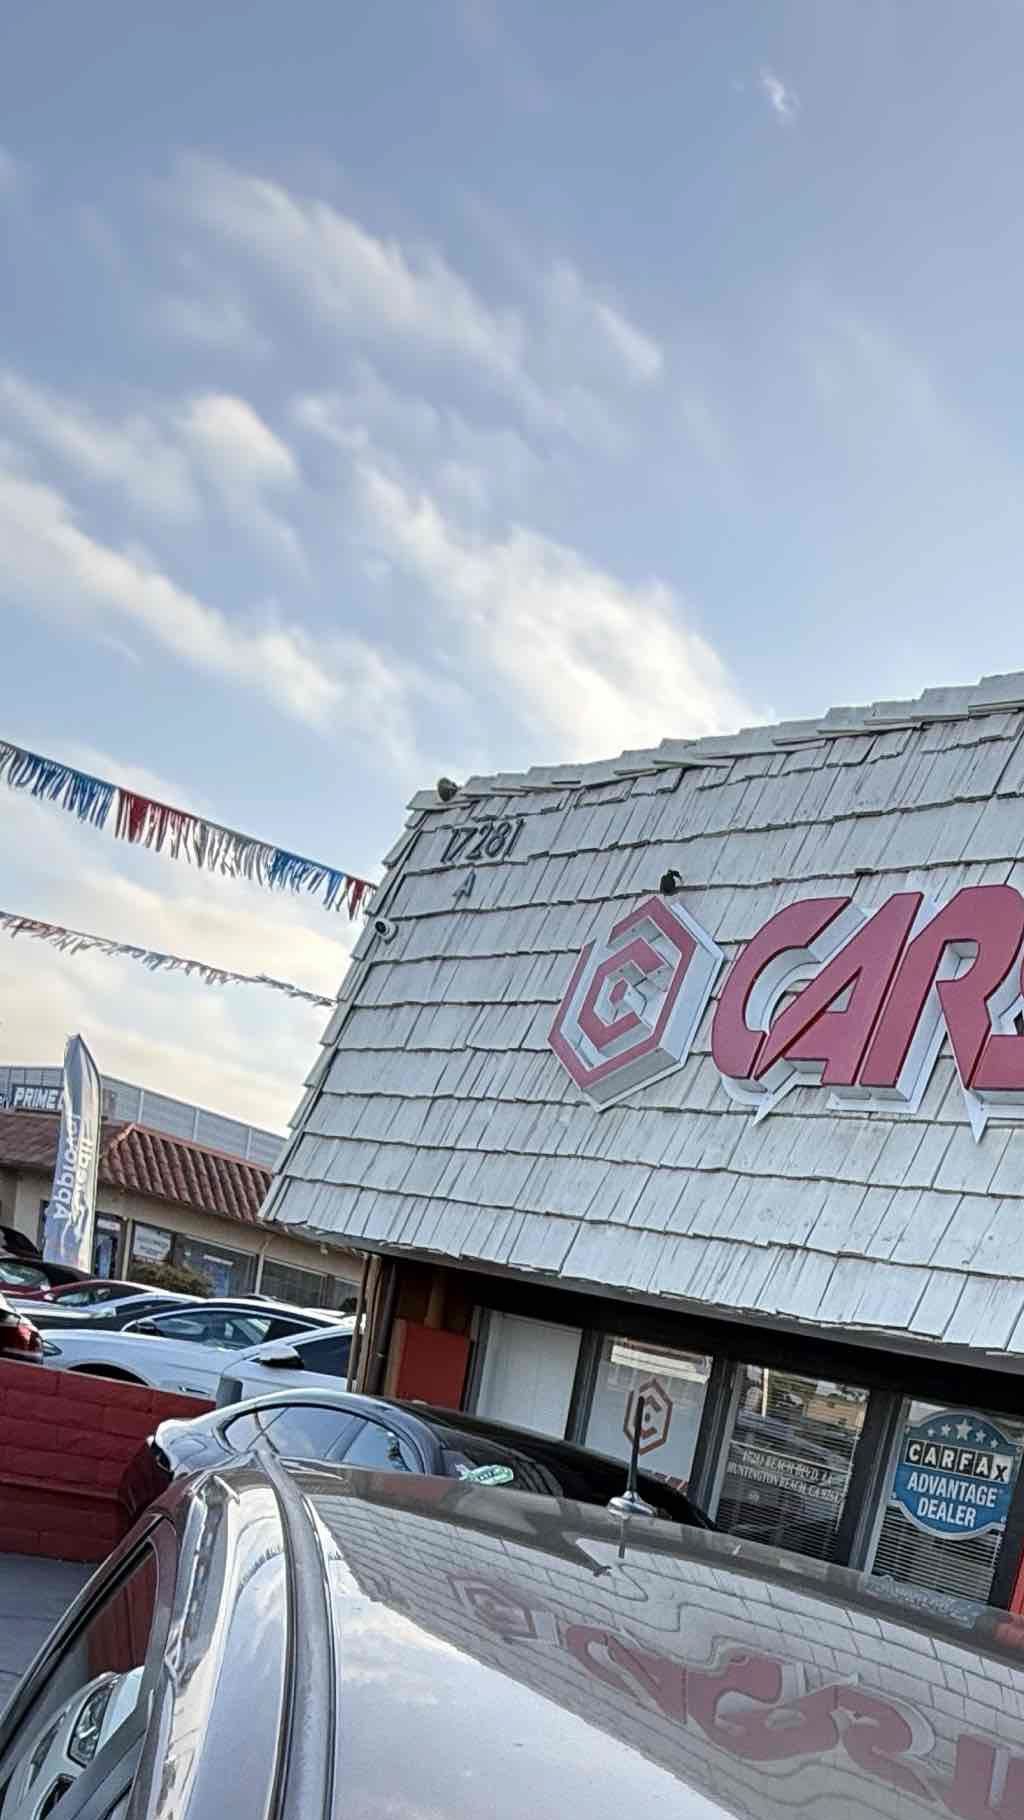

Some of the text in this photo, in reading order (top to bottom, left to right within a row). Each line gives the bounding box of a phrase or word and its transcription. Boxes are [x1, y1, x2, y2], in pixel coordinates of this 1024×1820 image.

[440, 819, 526, 863] 17281
[453, 869, 476, 897] A
[14, 1087, 58, 1110] PRIME
[908, 1442, 1009, 1483] CARFAX
[907, 1471, 998, 1508] ADVANTAGE
[917, 1497, 977, 1528] DEALER
